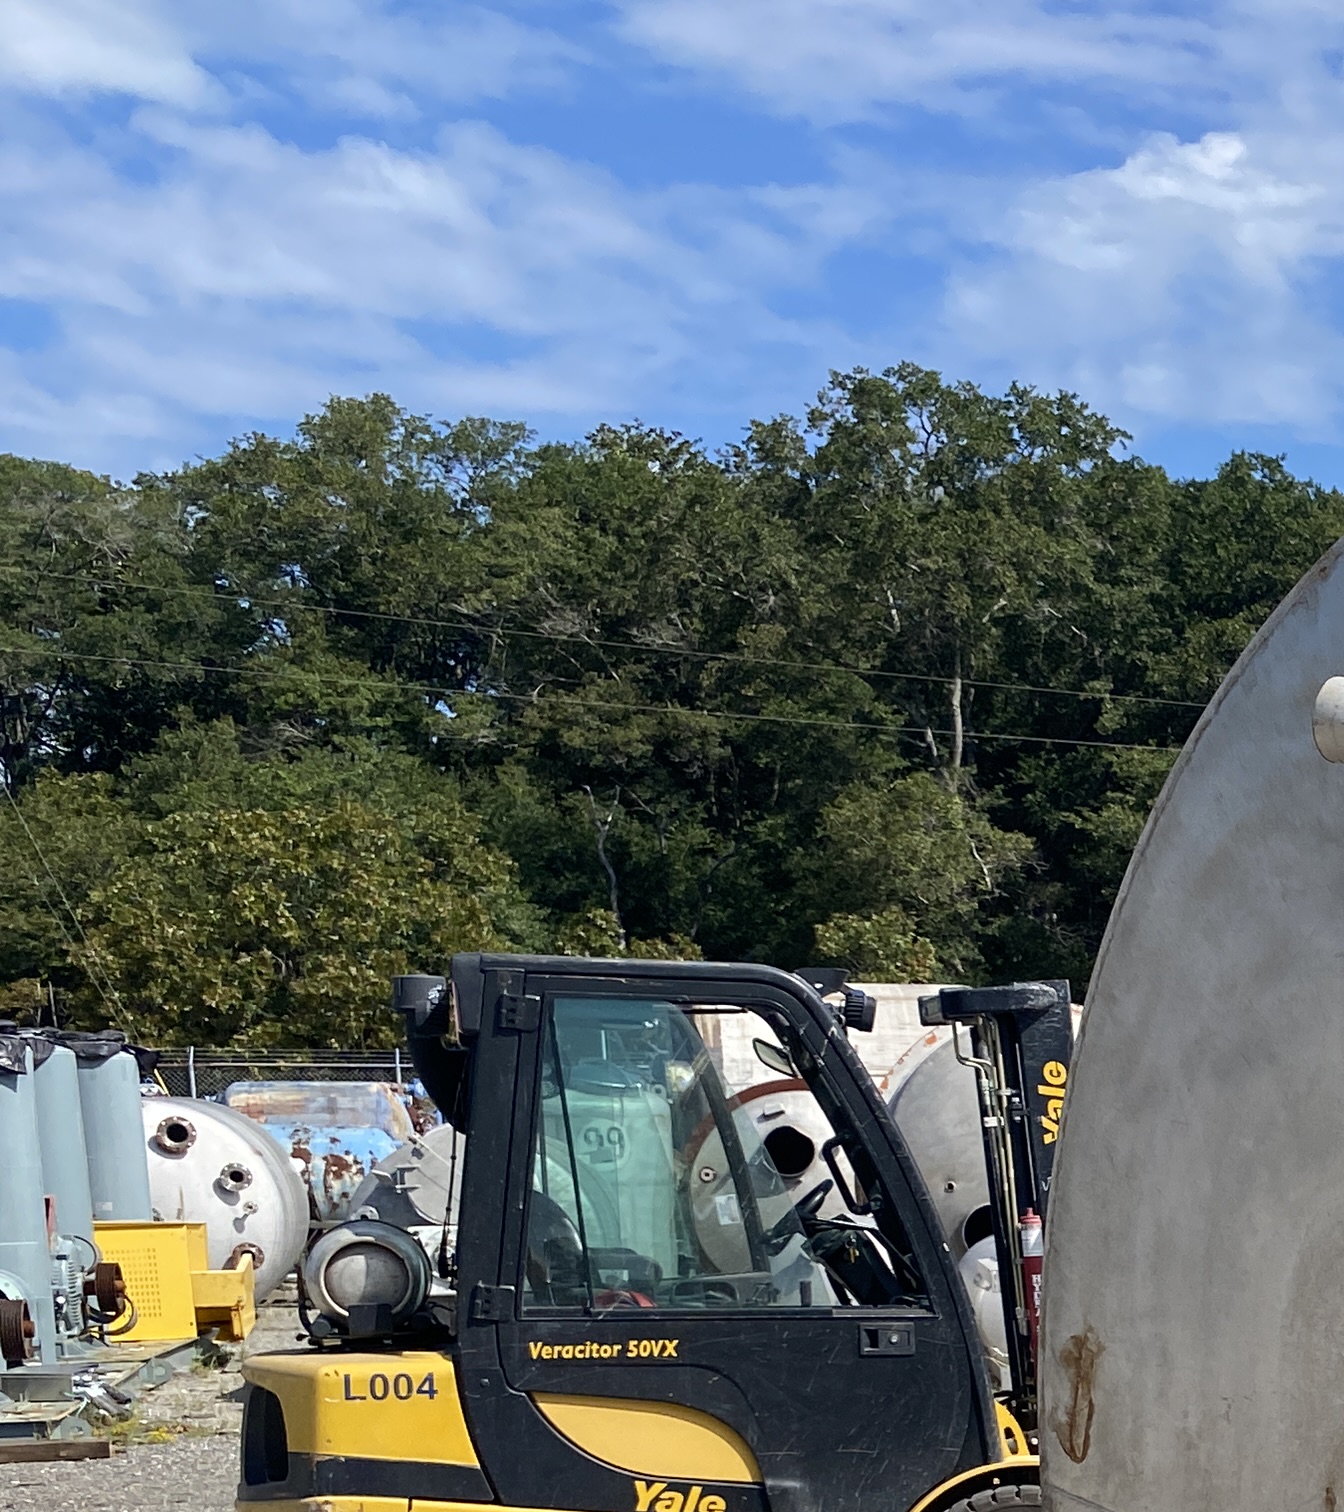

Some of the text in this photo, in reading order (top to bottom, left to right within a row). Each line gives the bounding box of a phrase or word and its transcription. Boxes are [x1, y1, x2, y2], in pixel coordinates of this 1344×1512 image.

[1037, 1061, 1067, 1145] Yale
[528, 1339, 680, 1360] Veracitor 50VX
[343, 1372, 439, 1401] L004
